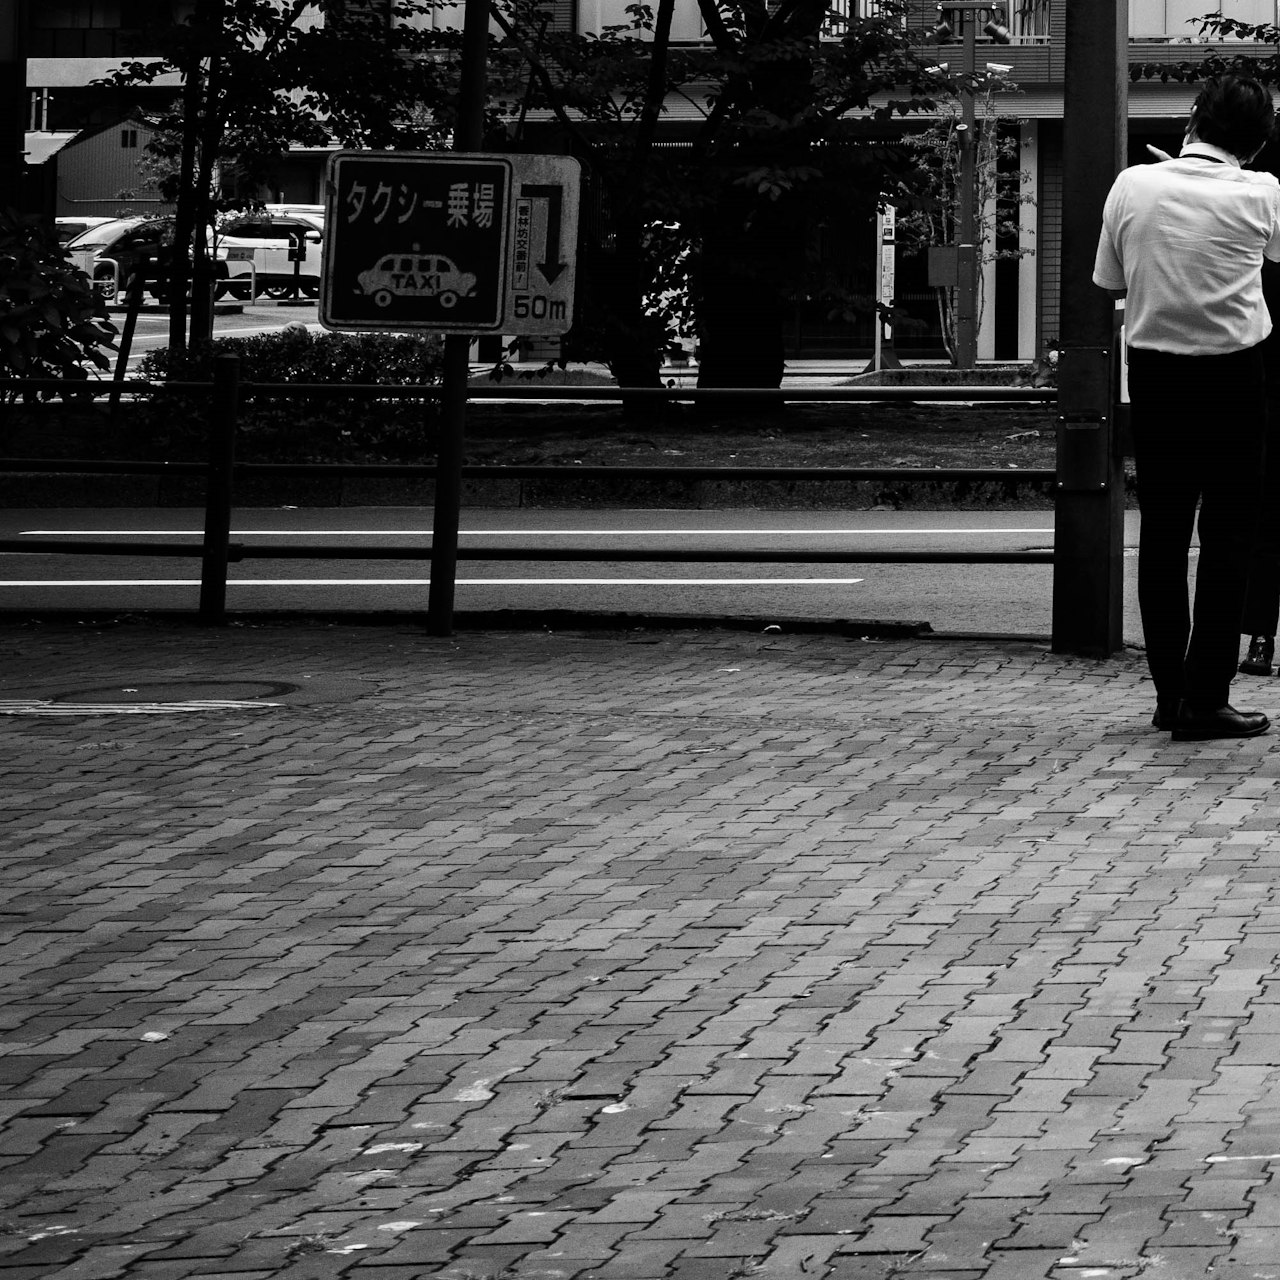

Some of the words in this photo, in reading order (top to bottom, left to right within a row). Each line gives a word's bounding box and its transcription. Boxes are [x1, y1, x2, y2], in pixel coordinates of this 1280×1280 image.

[346, 180, 496, 230] タクシー乗場
[392, 274, 441, 290] TAXI
[514, 294, 567, 320] 50m
